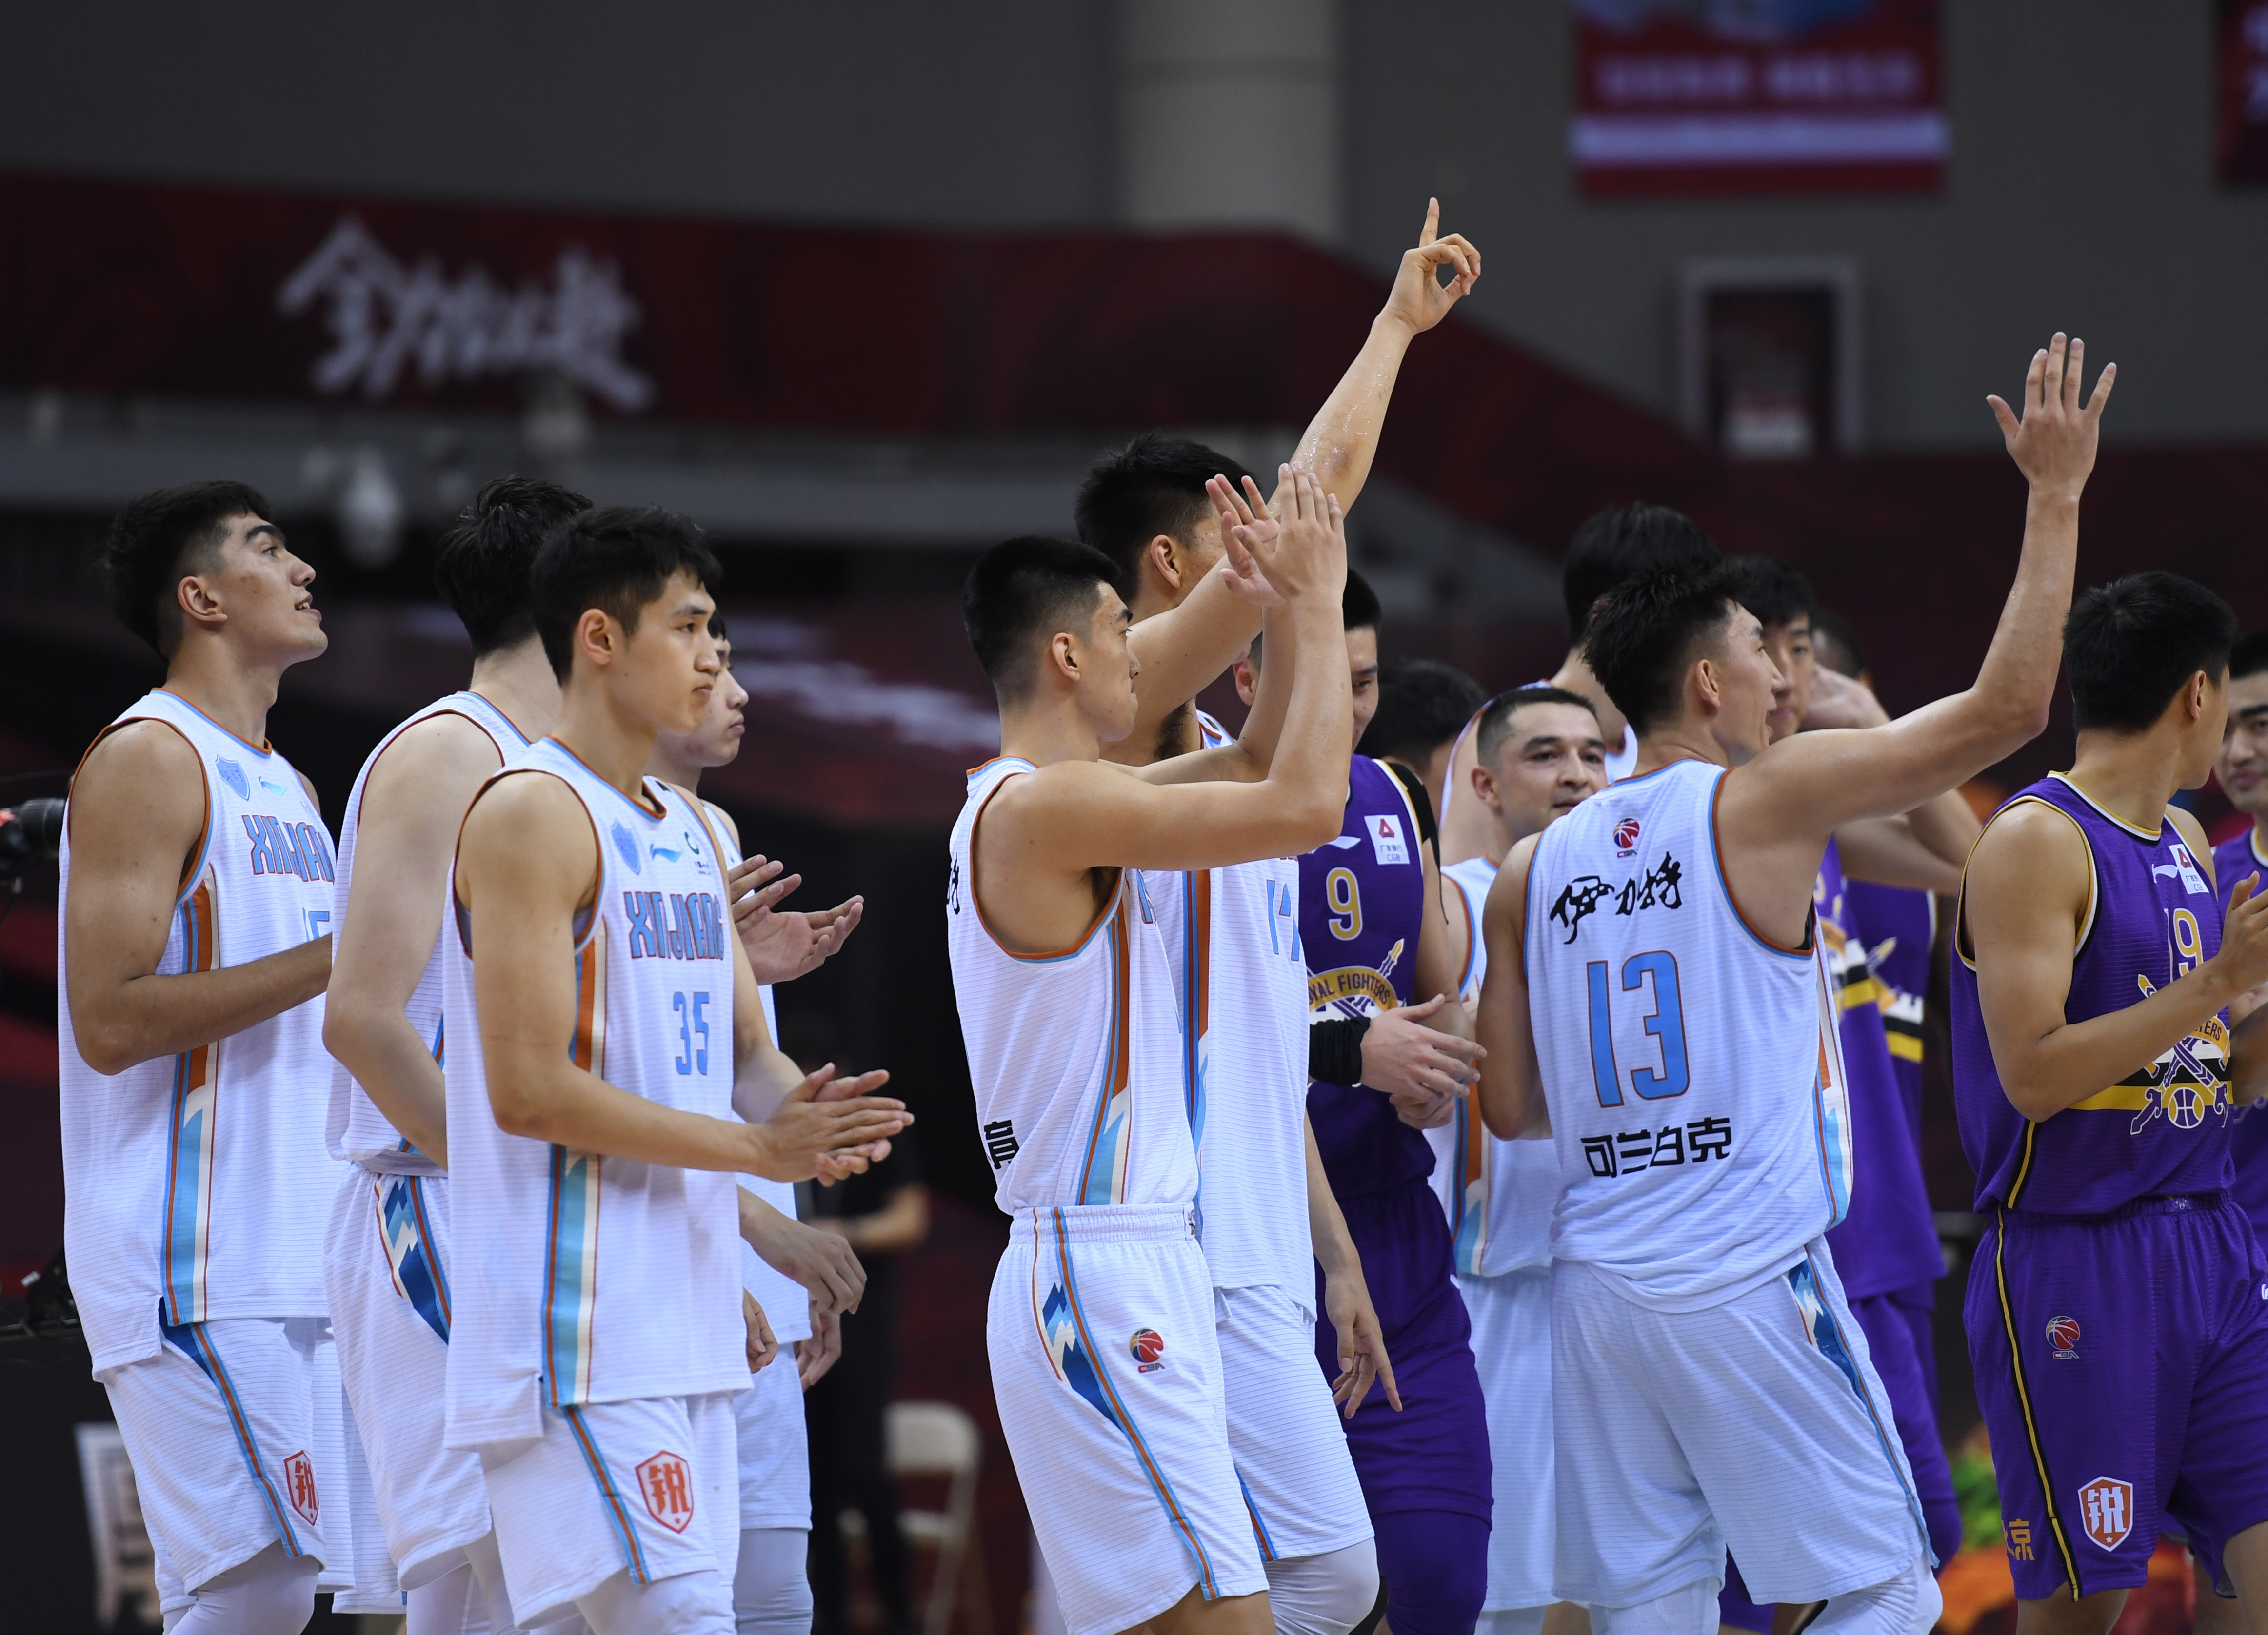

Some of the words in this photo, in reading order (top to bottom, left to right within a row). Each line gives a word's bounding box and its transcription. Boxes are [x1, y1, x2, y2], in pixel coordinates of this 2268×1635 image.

[1387, 853, 1401, 862] CGB
[1326, 867, 1363, 941] 9
[1337, 973, 1390, 1005] FIGHTERS
[673, 991, 710, 1075] 35
[1587, 949, 1690, 1108] 13
[1580, 1117, 1732, 1178] 可兰白克
[1138, 1362, 1166, 1374] CBA
[2052, 1350, 2080, 1359] CBA
[2087, 1486, 2128, 1535] 锐
